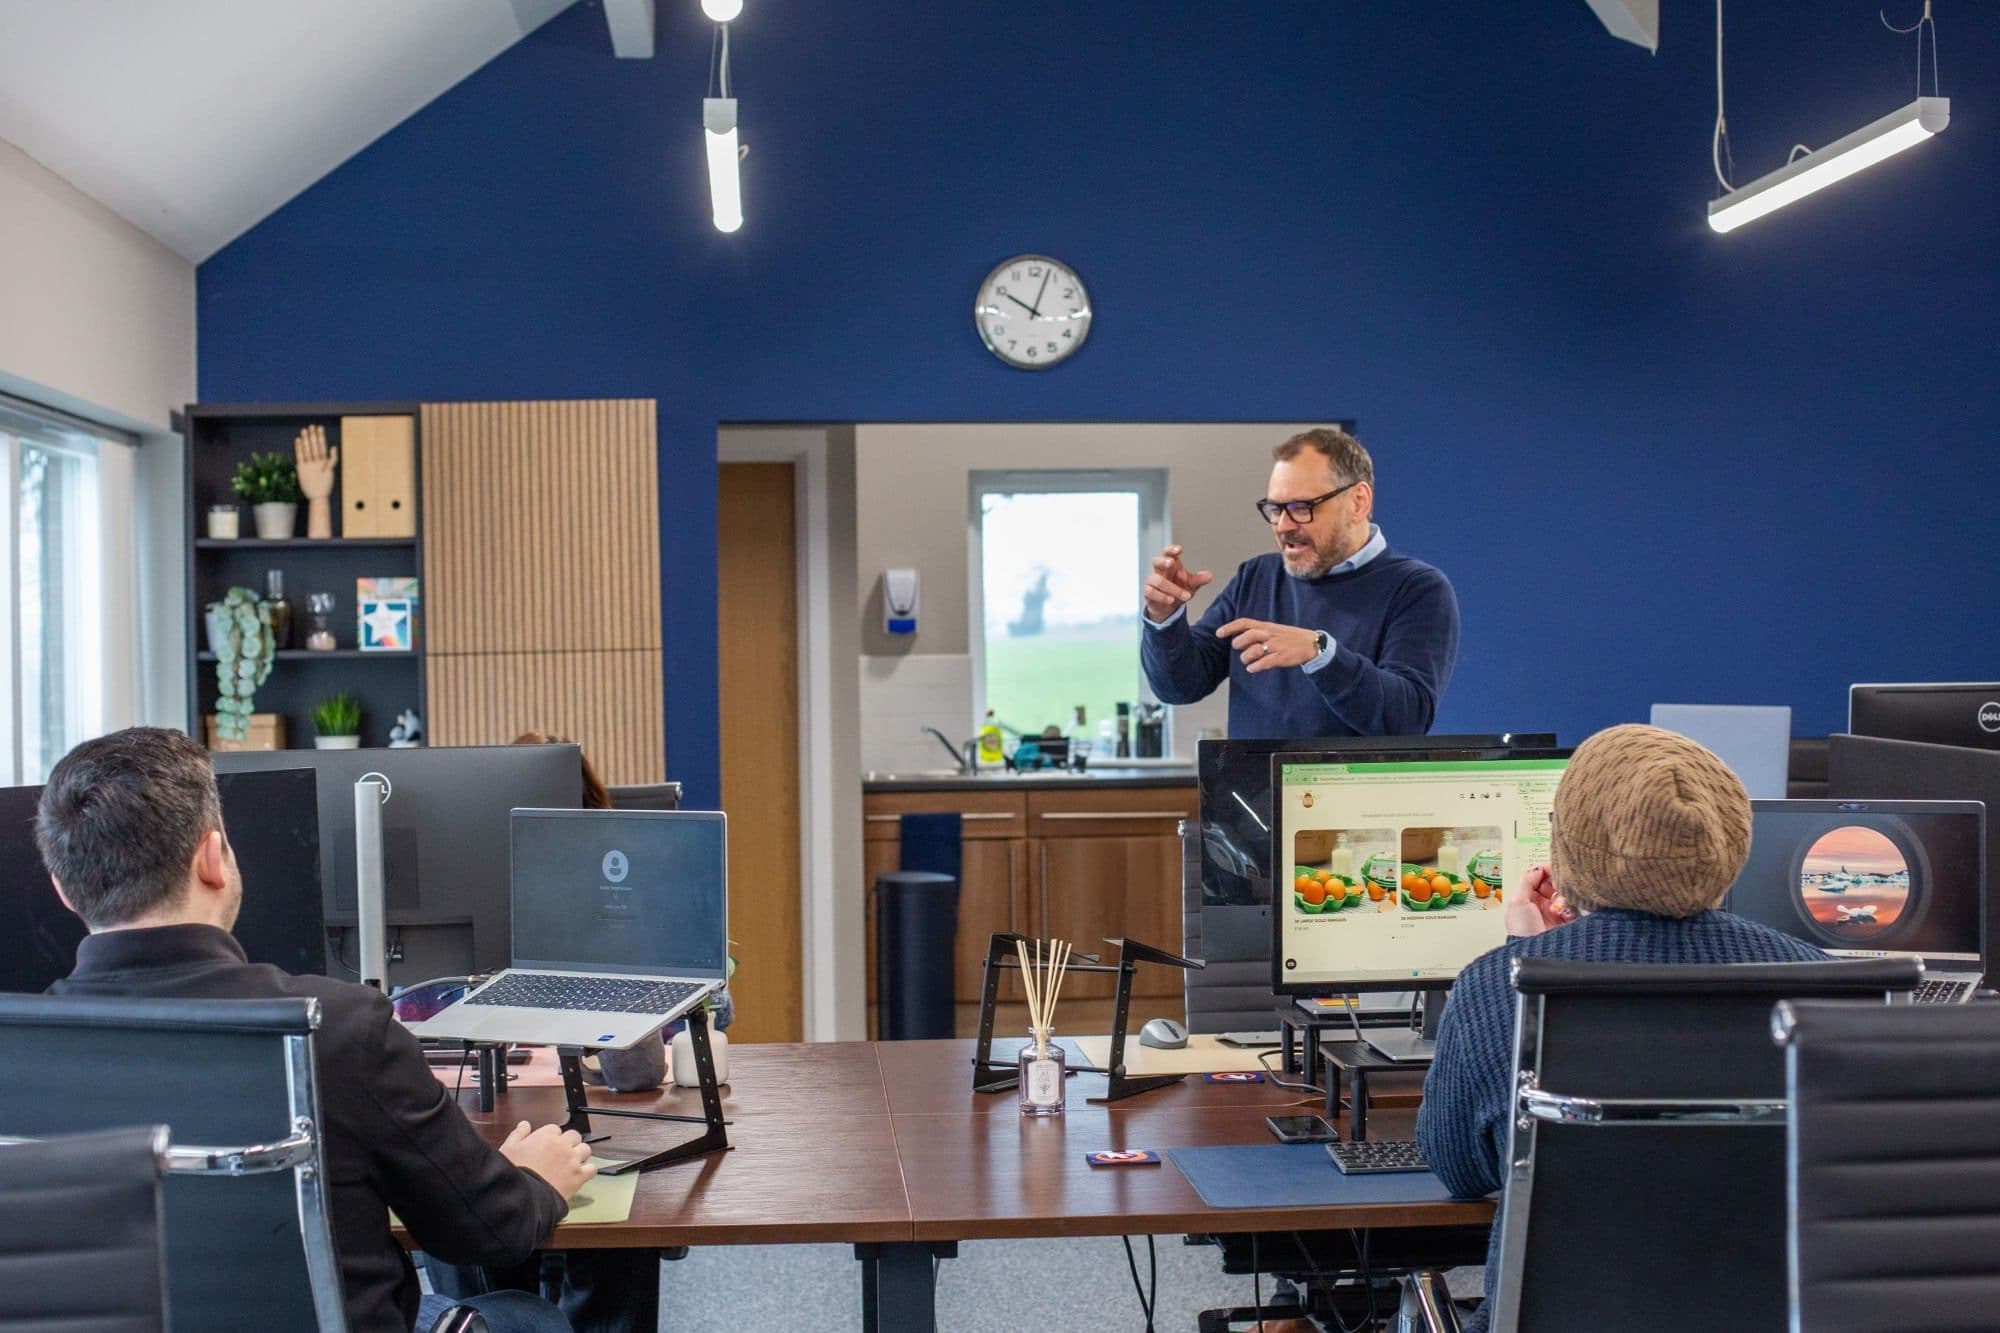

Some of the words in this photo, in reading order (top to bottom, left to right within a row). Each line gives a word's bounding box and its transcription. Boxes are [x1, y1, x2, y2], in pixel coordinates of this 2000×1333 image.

[1012, 272, 1021, 281] 11
[1028, 266, 1042, 278] 12
[1053, 272, 1058, 283] 1
[996, 285, 1007, 296] 10
[1063, 287, 1073, 299] 2
[1062, 328, 1072, 338] 4
[1007, 340, 1017, 351] 7
[1047, 341, 1058, 353] 5
[1026, 346, 1037, 357] 6
